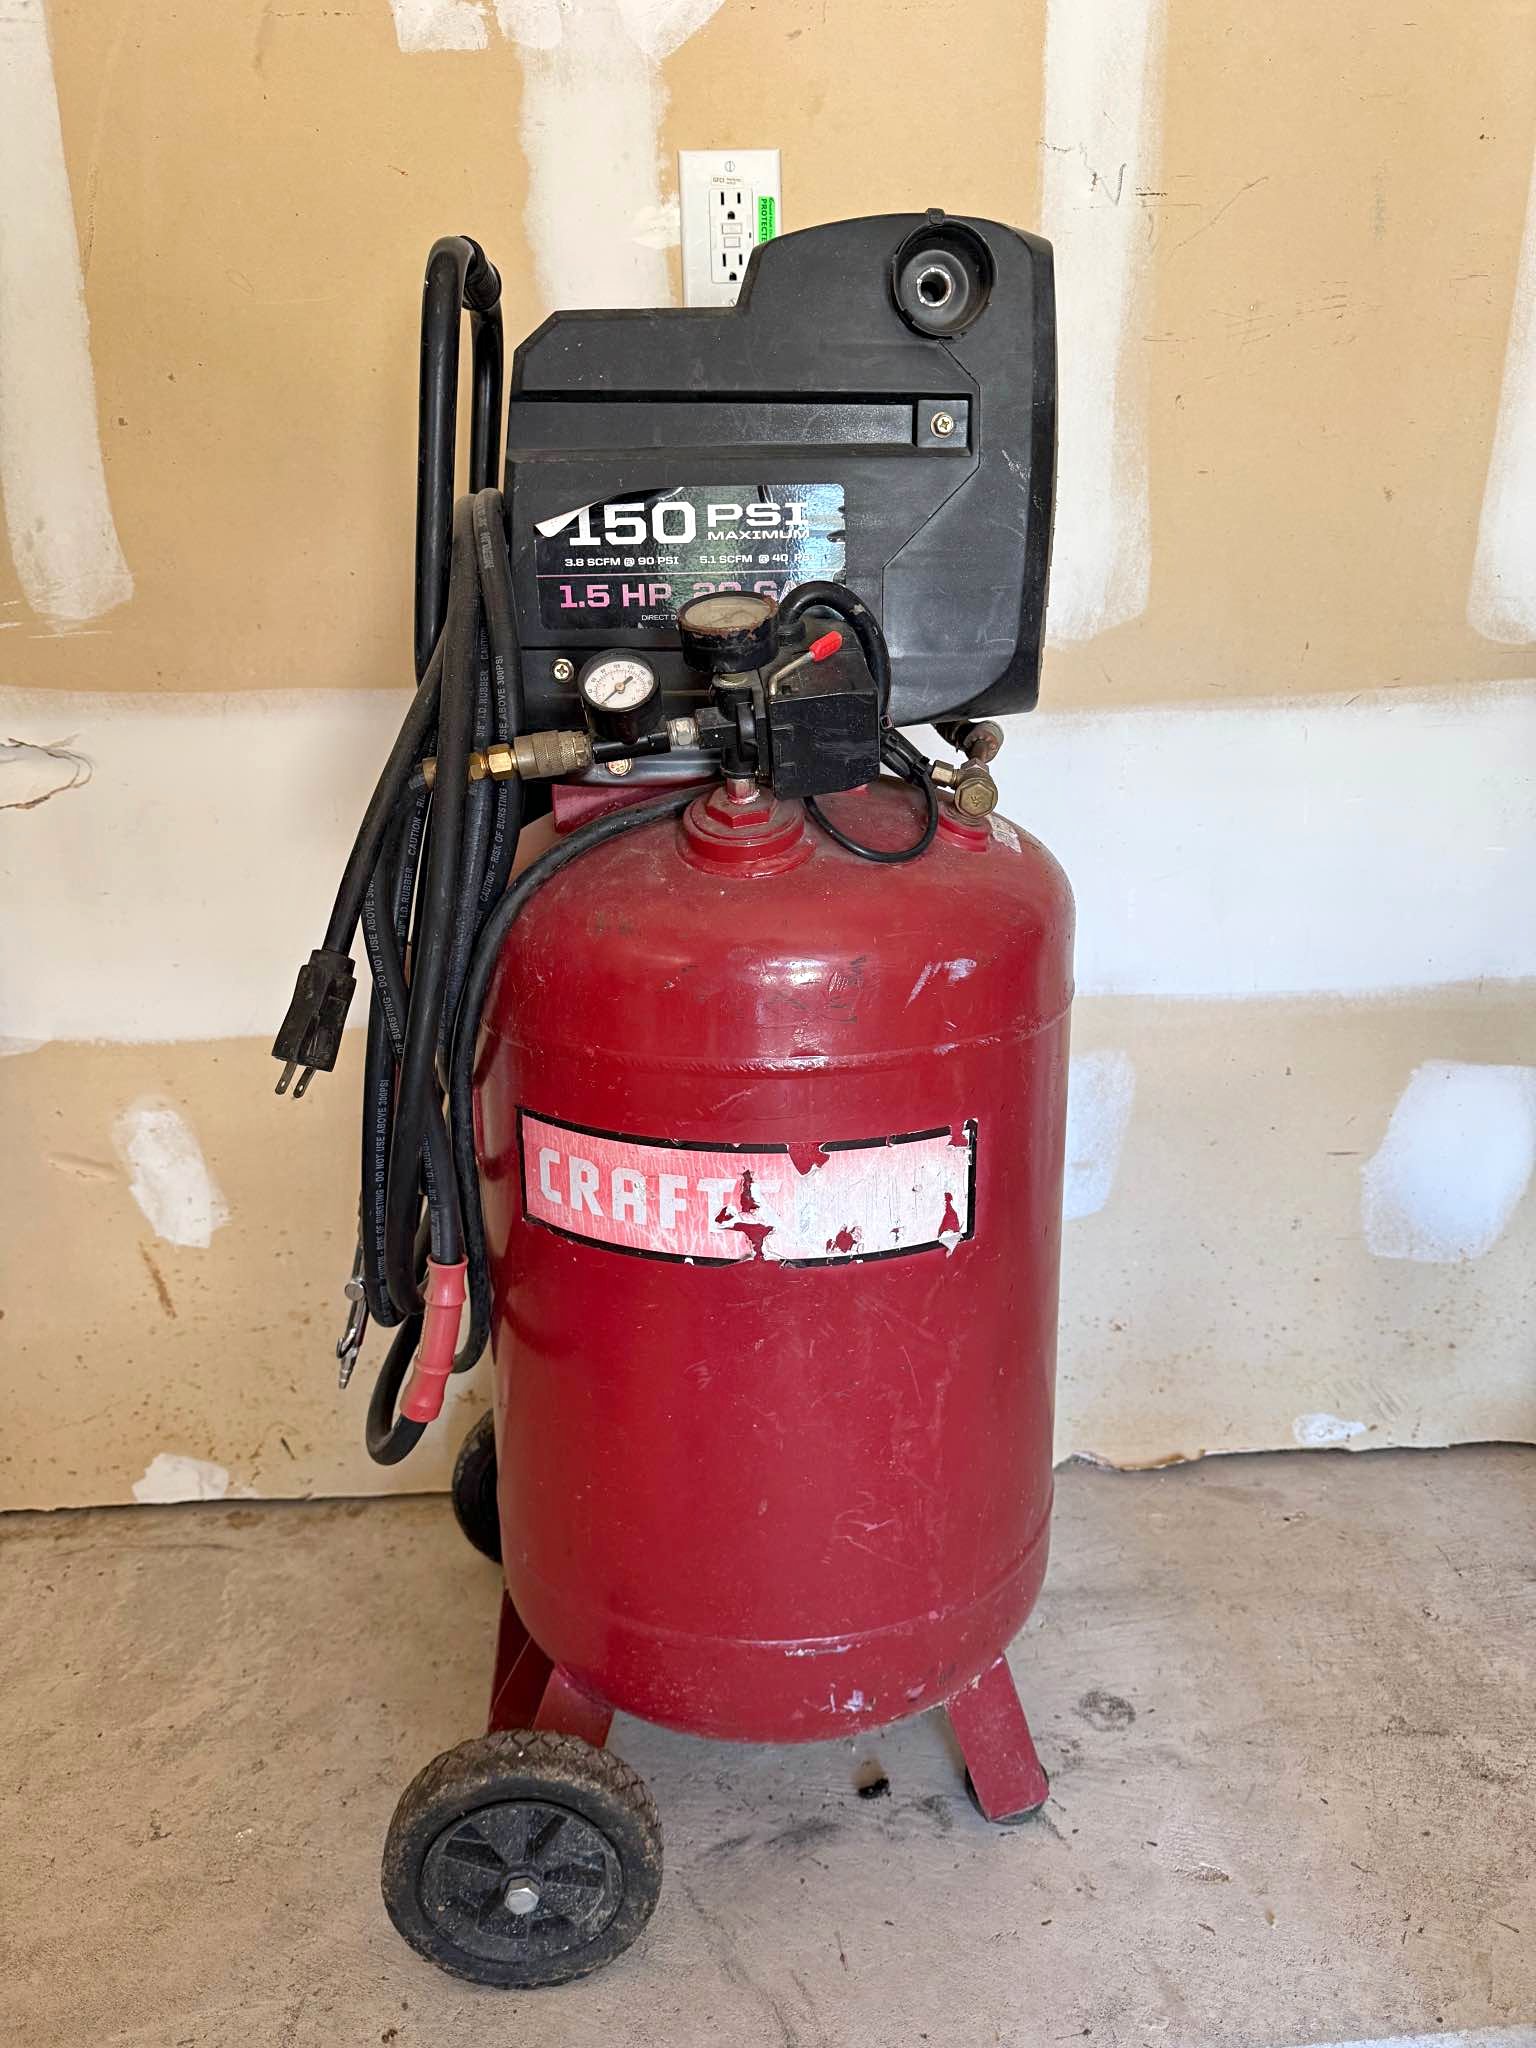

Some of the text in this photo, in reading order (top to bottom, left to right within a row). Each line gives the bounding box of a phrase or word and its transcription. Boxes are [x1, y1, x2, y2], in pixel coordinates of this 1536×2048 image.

[570, 501, 809, 546] 150 PSI
[707, 529, 810, 541] MAXIMUM
[564, 556, 679, 567] 3.8 SCFM @ 90 PSI
[699, 555, 717, 564] 5.1
[719, 554, 753, 564] SCFM
[758, 554, 770, 564] @
[772, 554, 789, 562] 40
[559, 584, 611, 608] 1.5
[622, 583, 673, 607] HP
[495, 655, 505, 685] 300PSI
[498, 688, 507, 720] ABOVE
[498, 723, 508, 741] USE
[496, 788, 508, 830] BURSTING
[494, 830, 504, 843] OF
[402, 866, 414, 903] RUBBER
[408, 817, 422, 856] CAUTION
[490, 845, 502, 863] RISK
[479, 870, 495, 903] CAUTION
[365, 900, 377, 931] ABOVE
[368, 933, 380, 951] USE
[372, 954, 384, 973] NOT
[376, 974, 387, 988] DO
[383, 996, 402, 1040] BURSTING
[378, 1079, 390, 1106] 300PSI
[377, 1107, 387, 1134] ABOVE
[376, 1136, 386, 1152] USE
[376, 1154, 385, 1169] NOT
[376, 1171, 385, 1182] DO
[539, 1147, 782, 1235] CRAFT
